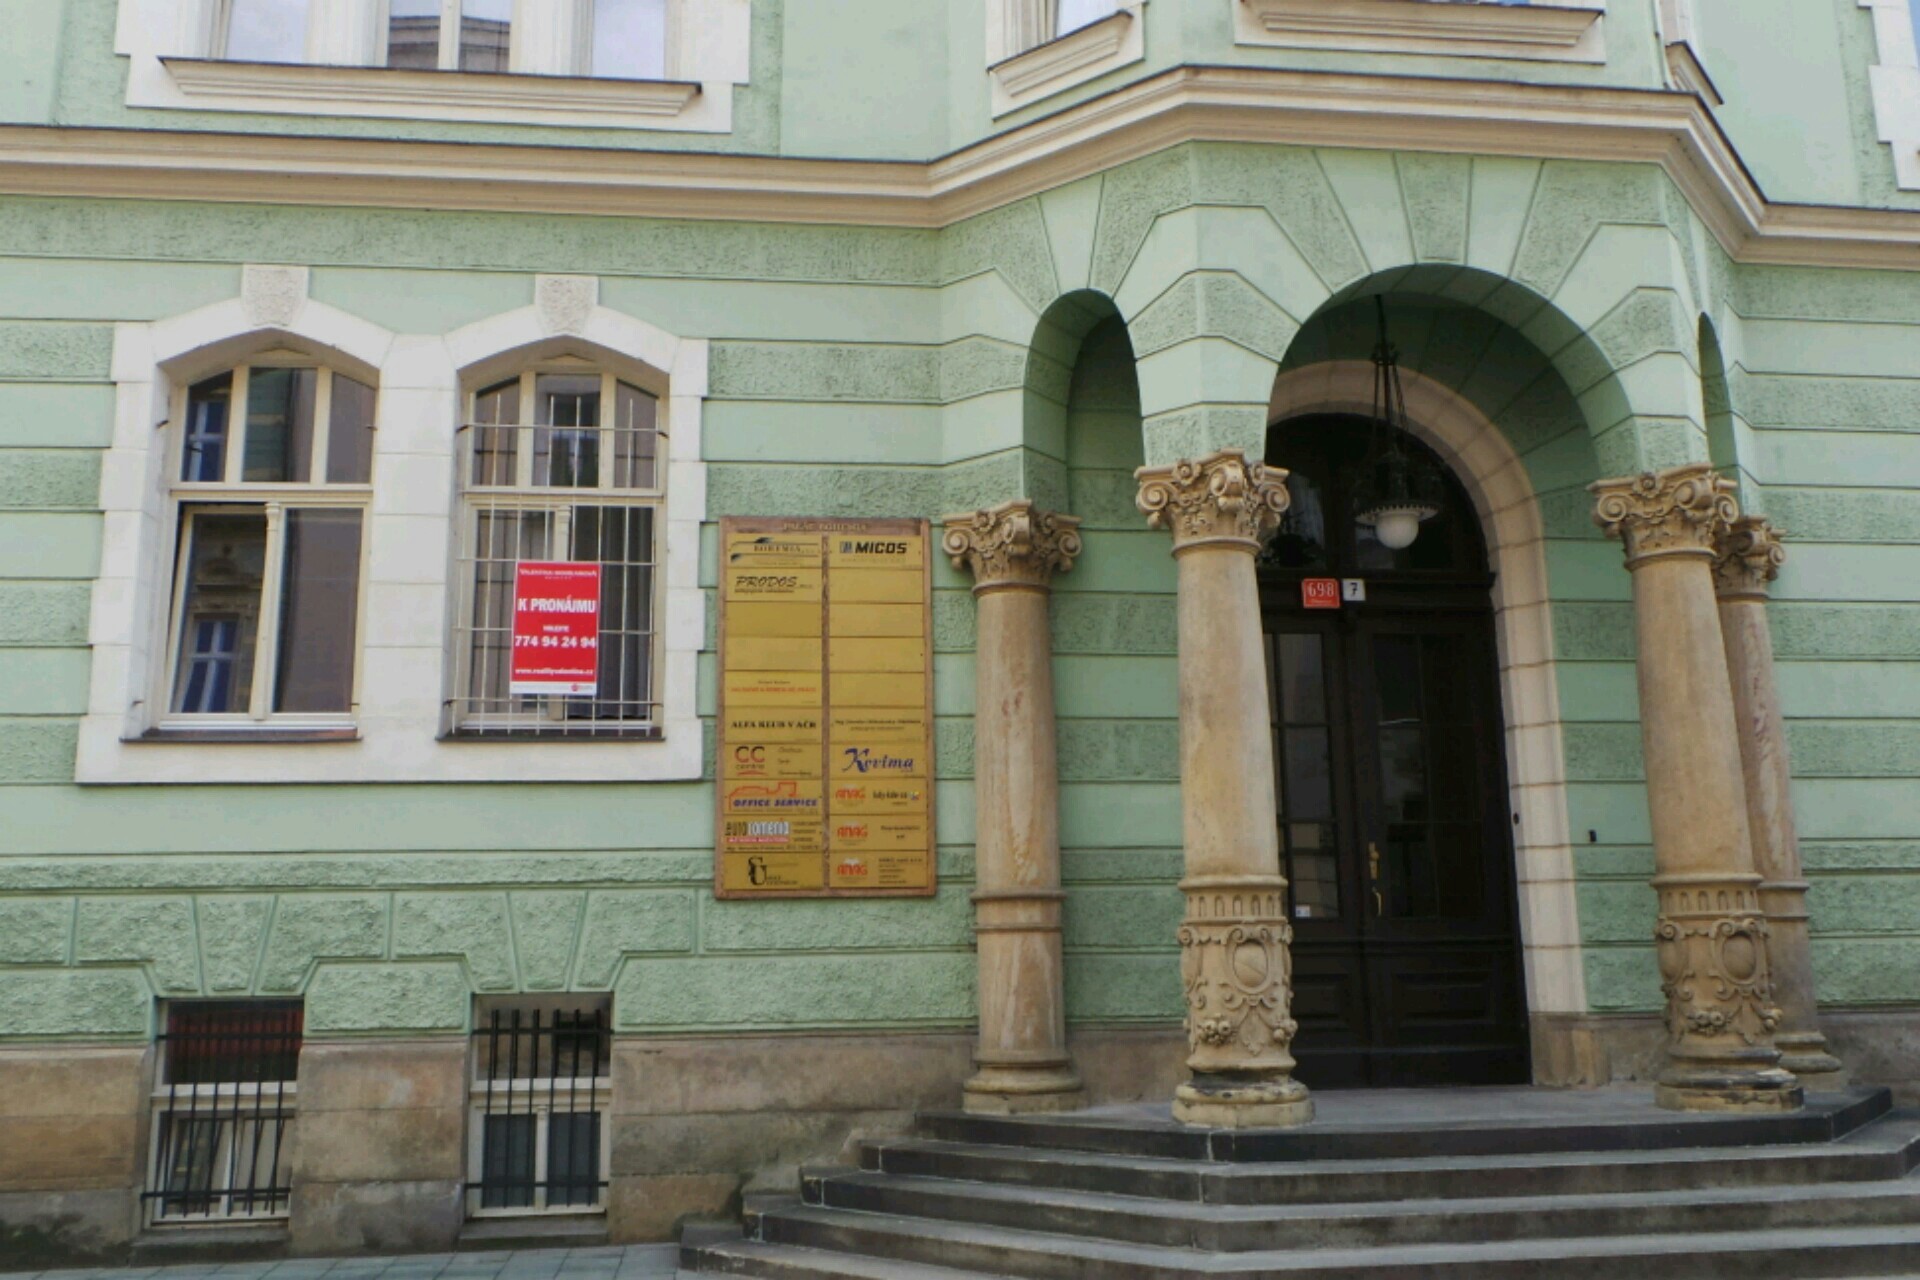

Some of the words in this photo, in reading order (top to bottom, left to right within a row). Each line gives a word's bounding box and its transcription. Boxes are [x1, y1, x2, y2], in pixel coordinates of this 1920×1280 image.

[855, 541, 907, 554] MICOS
[1308, 582, 1334, 597] 698
[1350, 582, 1359, 596] 7
[517, 598, 528, 612] K
[530, 594, 596, 613] PRONÁJMU
[514, 635, 539, 648] 774
[541, 636, 559, 648] 94
[561, 637, 578, 648] 24
[580, 637, 597, 649] 94
[734, 746, 766, 763] CC
[733, 799, 770, 807] OFFICE
[773, 799, 818, 807] SERVICE
